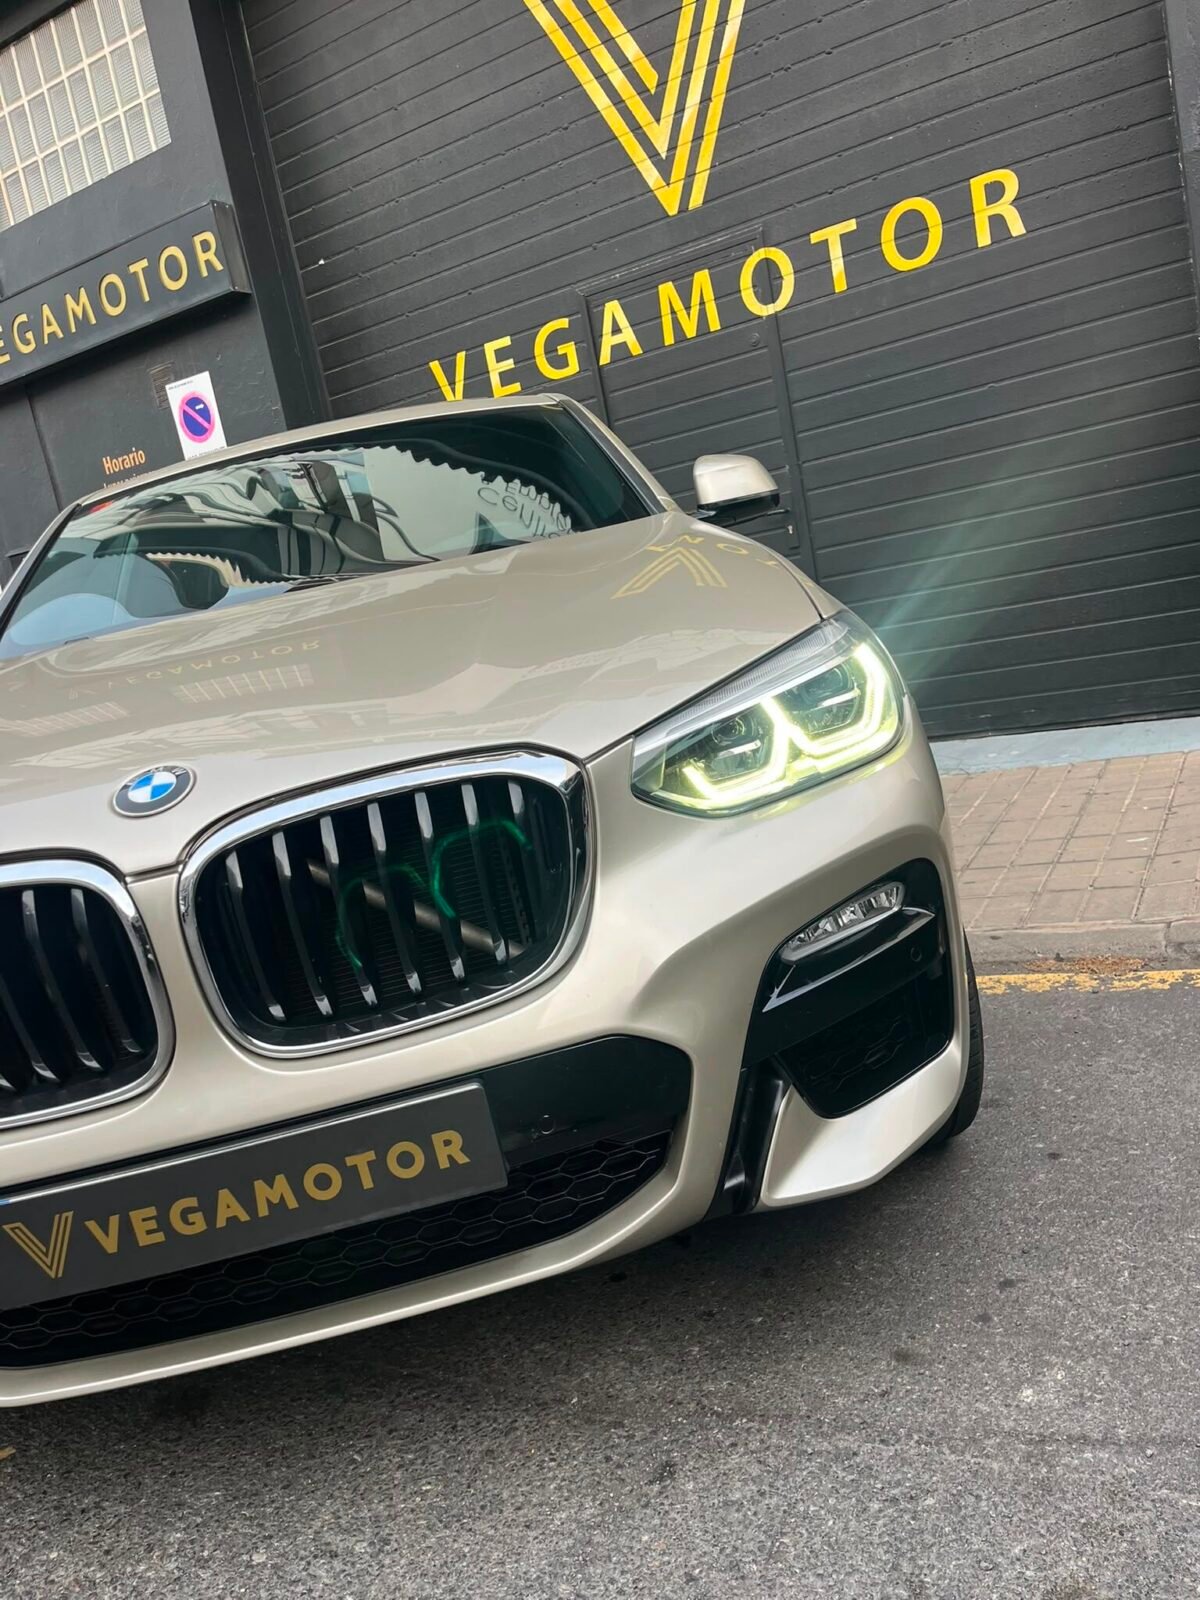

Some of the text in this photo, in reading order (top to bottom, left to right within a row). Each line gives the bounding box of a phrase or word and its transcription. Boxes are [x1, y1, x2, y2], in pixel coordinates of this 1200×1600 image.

[429, 168, 1026, 402] VEGAMOTOR
[102, 446, 146, 475] Horario
[84, 1129, 471, 1254] VEGAMOTOR
